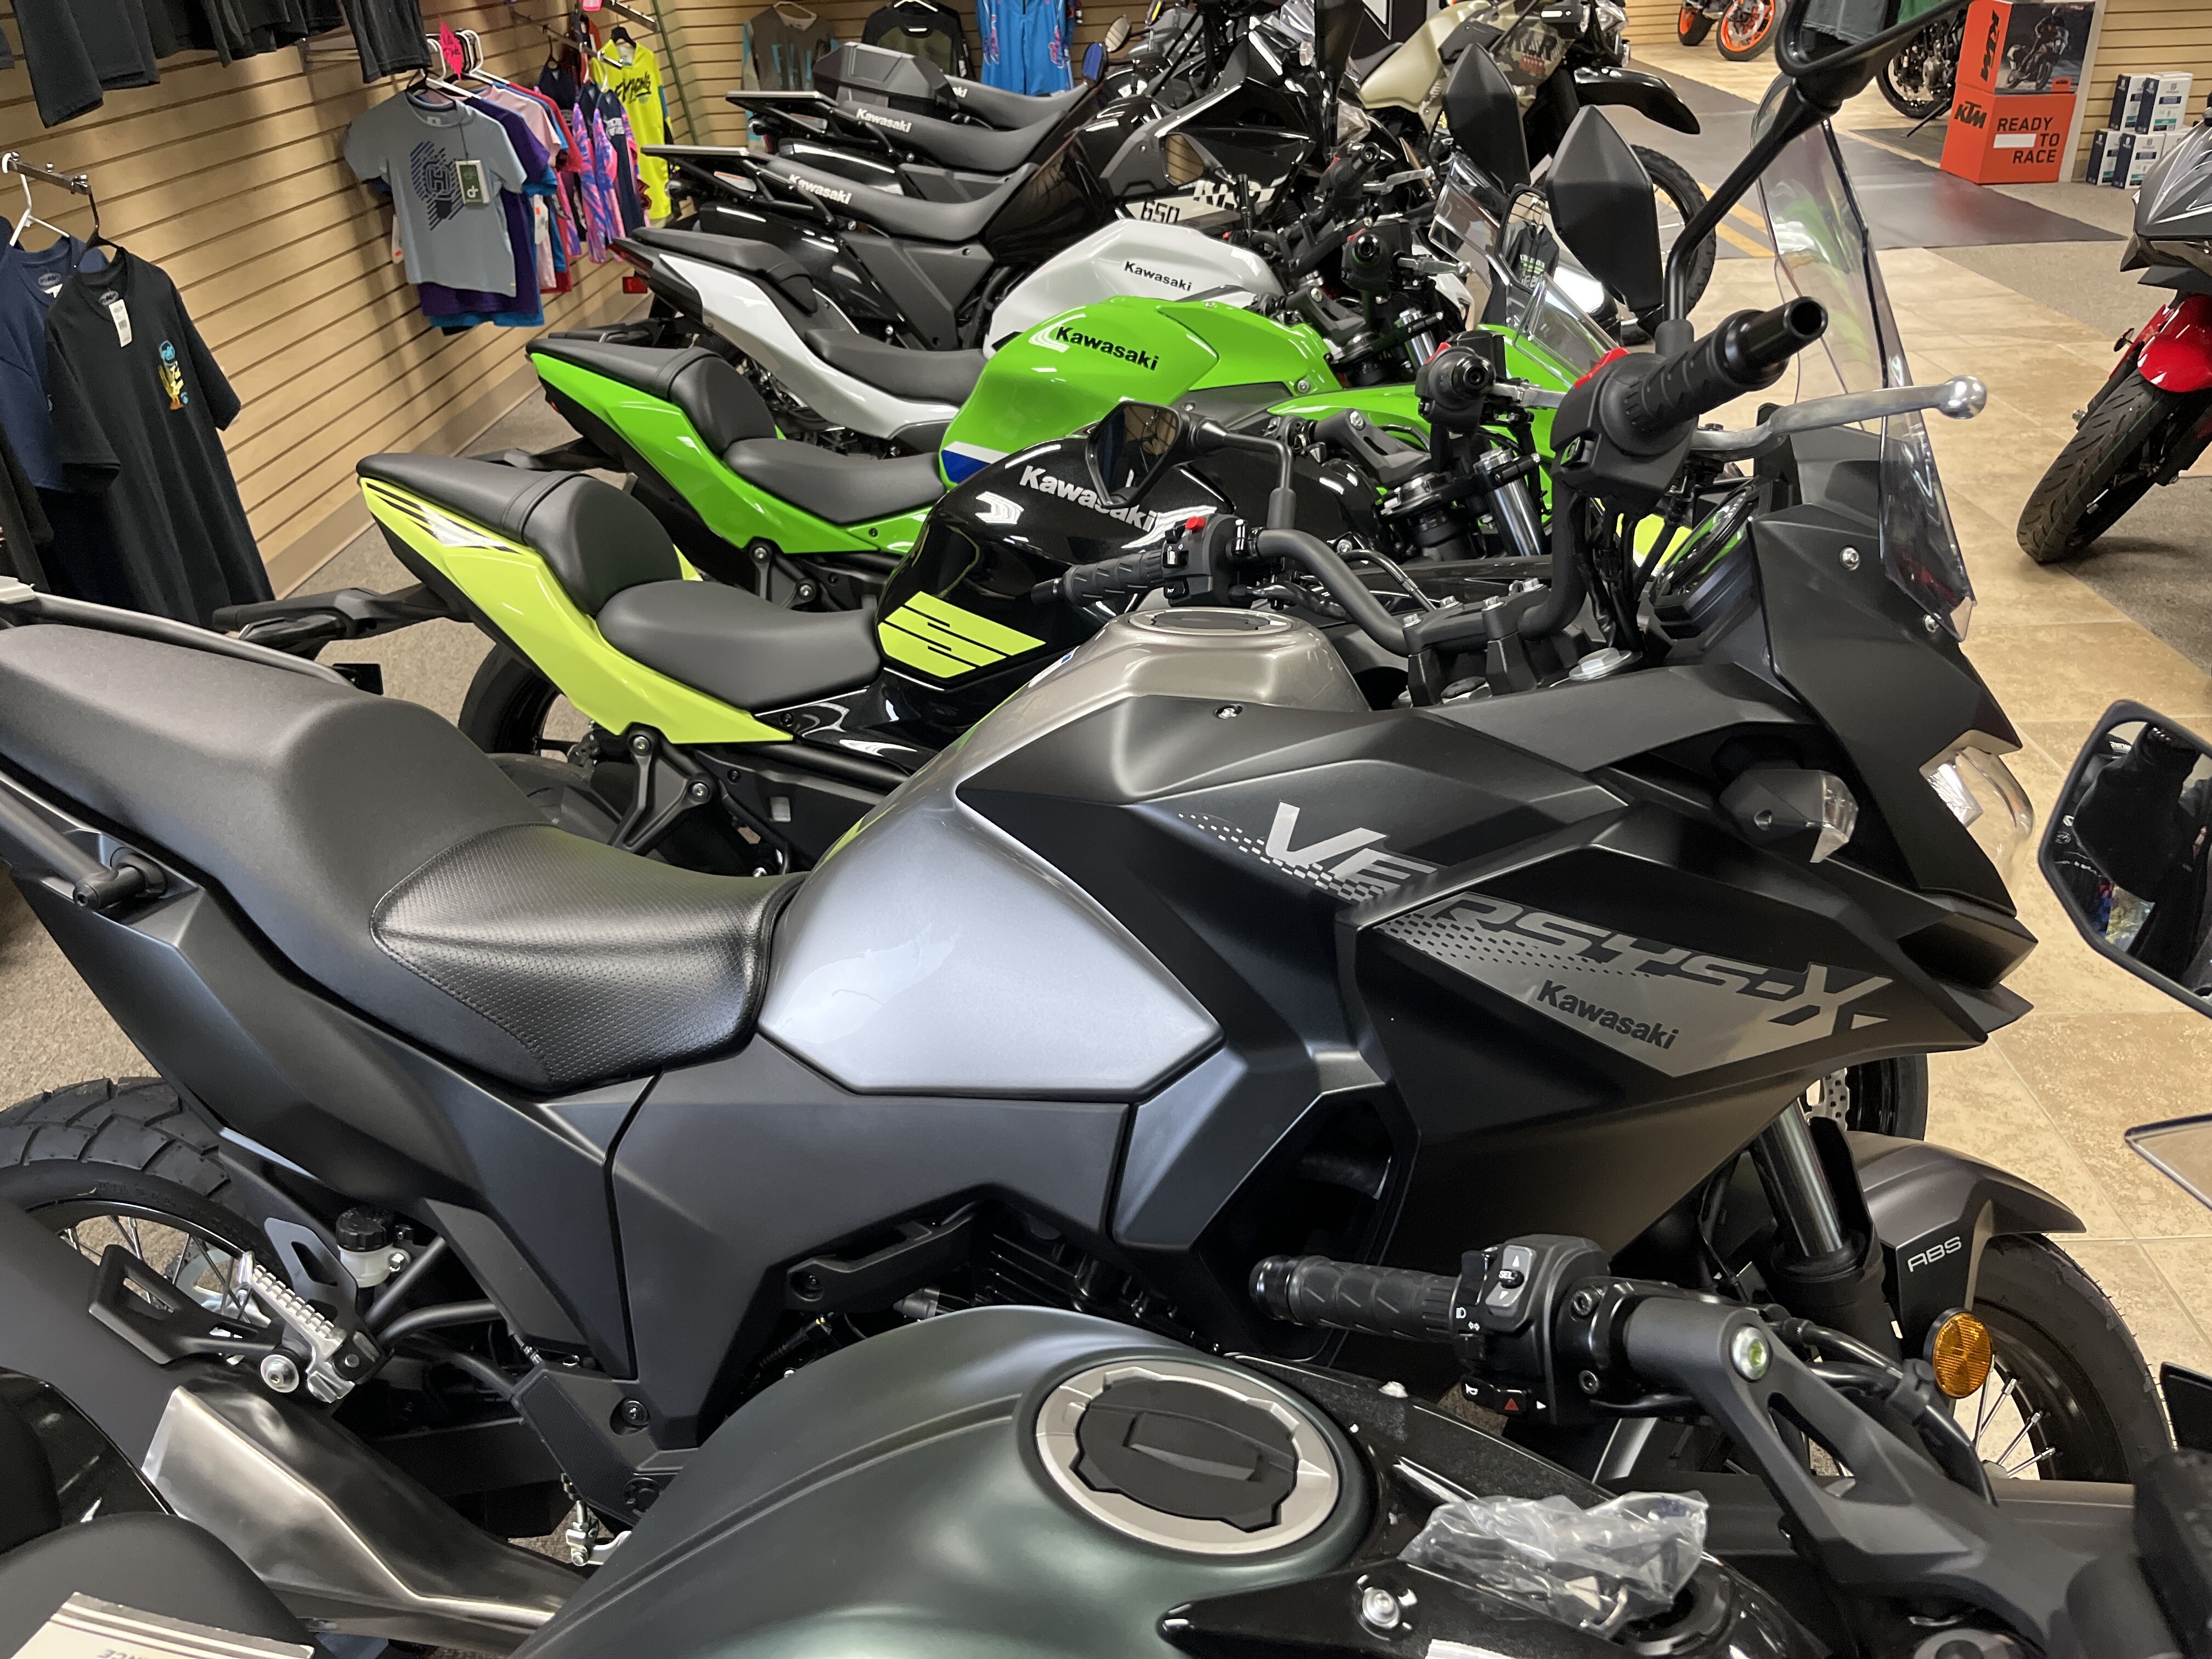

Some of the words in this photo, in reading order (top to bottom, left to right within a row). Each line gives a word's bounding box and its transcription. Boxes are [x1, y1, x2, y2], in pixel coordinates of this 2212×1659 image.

[856, 108, 912, 133] Kawasaki
[1954, 100, 1987, 129] KTM
[1996, 116, 2053, 132] READY
[2040, 133, 2060, 147] TO
[2012, 150, 2057, 163] RACE
[1141, 201, 1180, 223] 650
[1124, 261, 1192, 292] Kawasaki
[1056, 326, 1159, 371] Kawasaki
[1536, 979, 1679, 1050] Kawasaki
[1908, 1236, 1962, 1272] ABS
